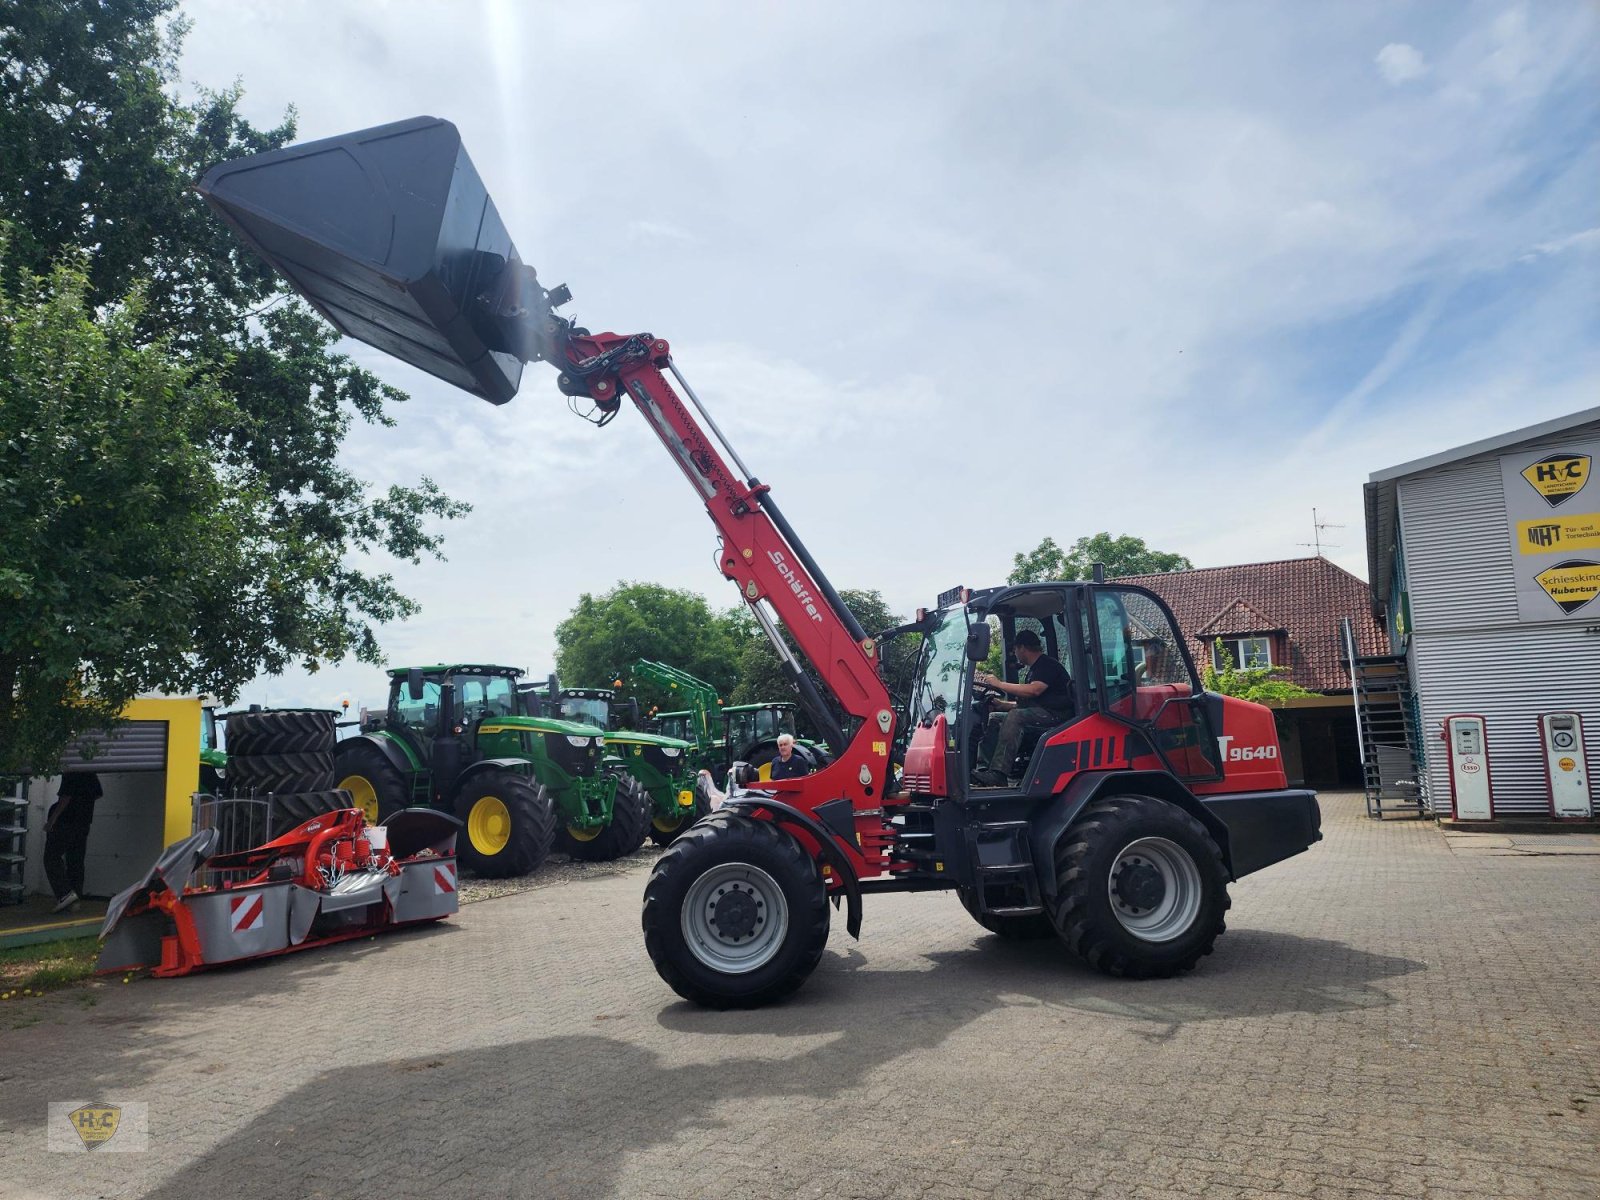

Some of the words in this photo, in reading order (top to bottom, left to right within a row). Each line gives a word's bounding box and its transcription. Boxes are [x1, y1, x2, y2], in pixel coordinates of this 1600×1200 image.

[1527, 524, 1561, 547] MHT
[767, 550, 823, 623] Schäffer
[1550, 586, 1598, 595] Hubertus
